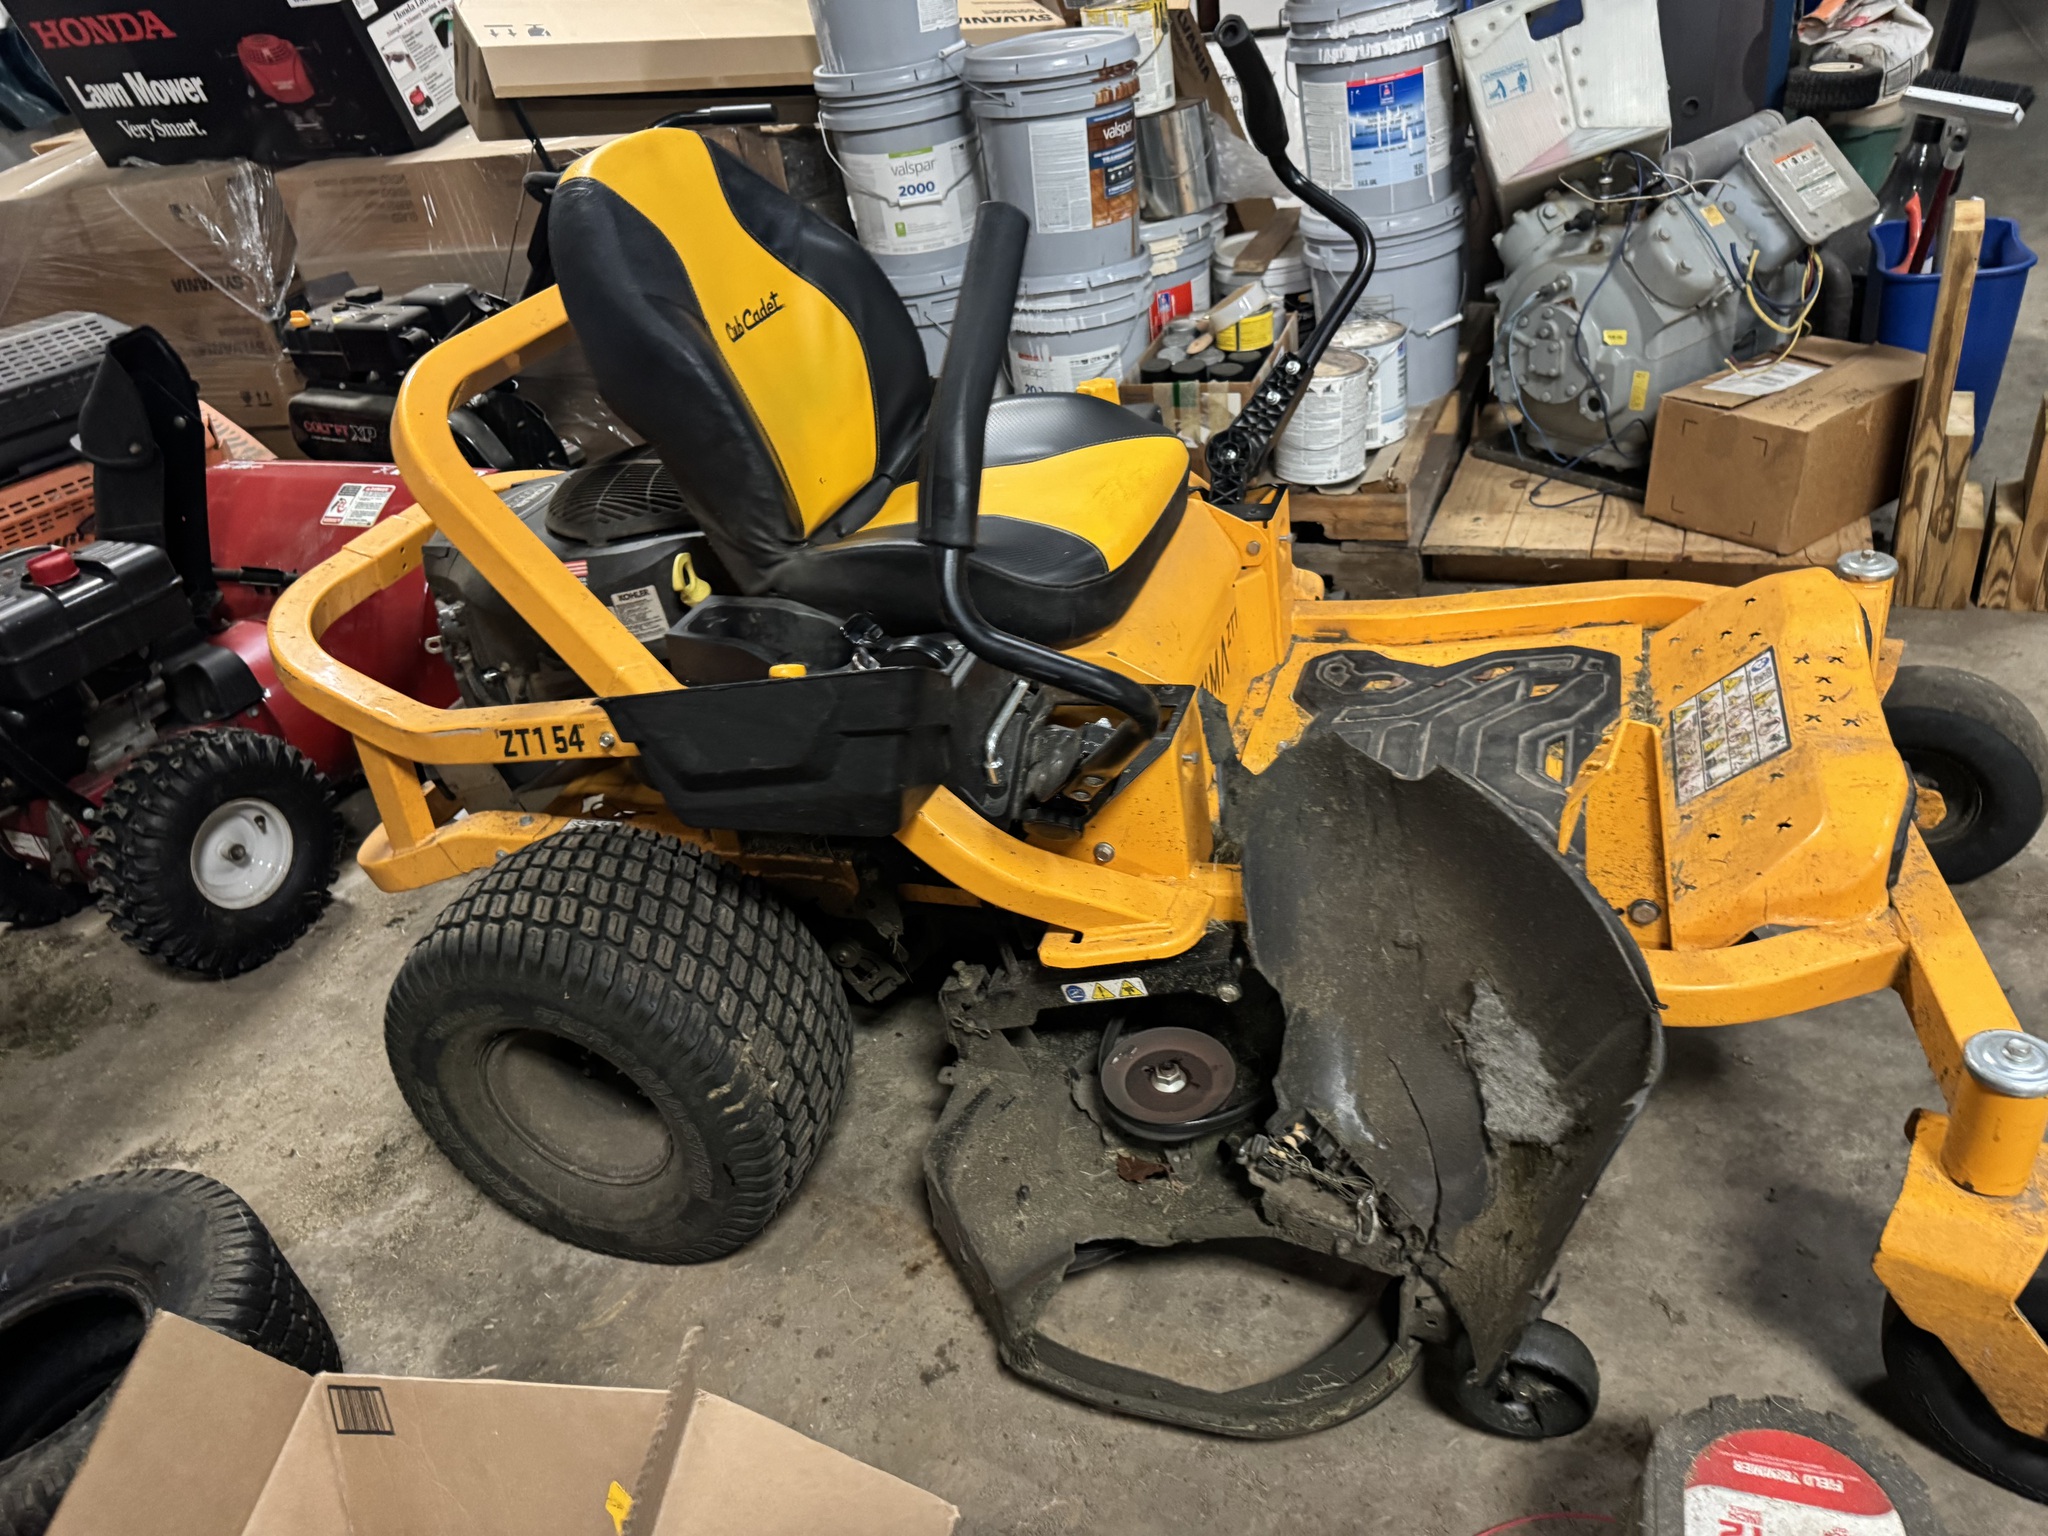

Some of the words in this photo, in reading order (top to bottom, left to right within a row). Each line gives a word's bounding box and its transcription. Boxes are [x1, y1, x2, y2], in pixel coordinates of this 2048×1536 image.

[393, 3, 416, 21] Honda
[30, 9, 177, 48] HONDA
[65, 76, 134, 109] Lawn
[122, 71, 208, 106] Mower
[117, 119, 155, 142] Very
[151, 118, 207, 138] Smart.
[1103, 120, 1133, 140] valspar
[891, 158, 936, 176] valspar
[898, 181, 935, 197] 2000
[725, 315, 745, 343] Cub
[742, 291, 786, 331] Cadet
[350, 424, 377, 443] XP
[617, 588, 651, 601] KOHLER
[500, 727, 547, 757] ZT1
[552, 724, 585, 754] 54
[1732, 1459, 1801, 1485] TRIMMER
[1802, 1473, 1844, 1493] FIELD
